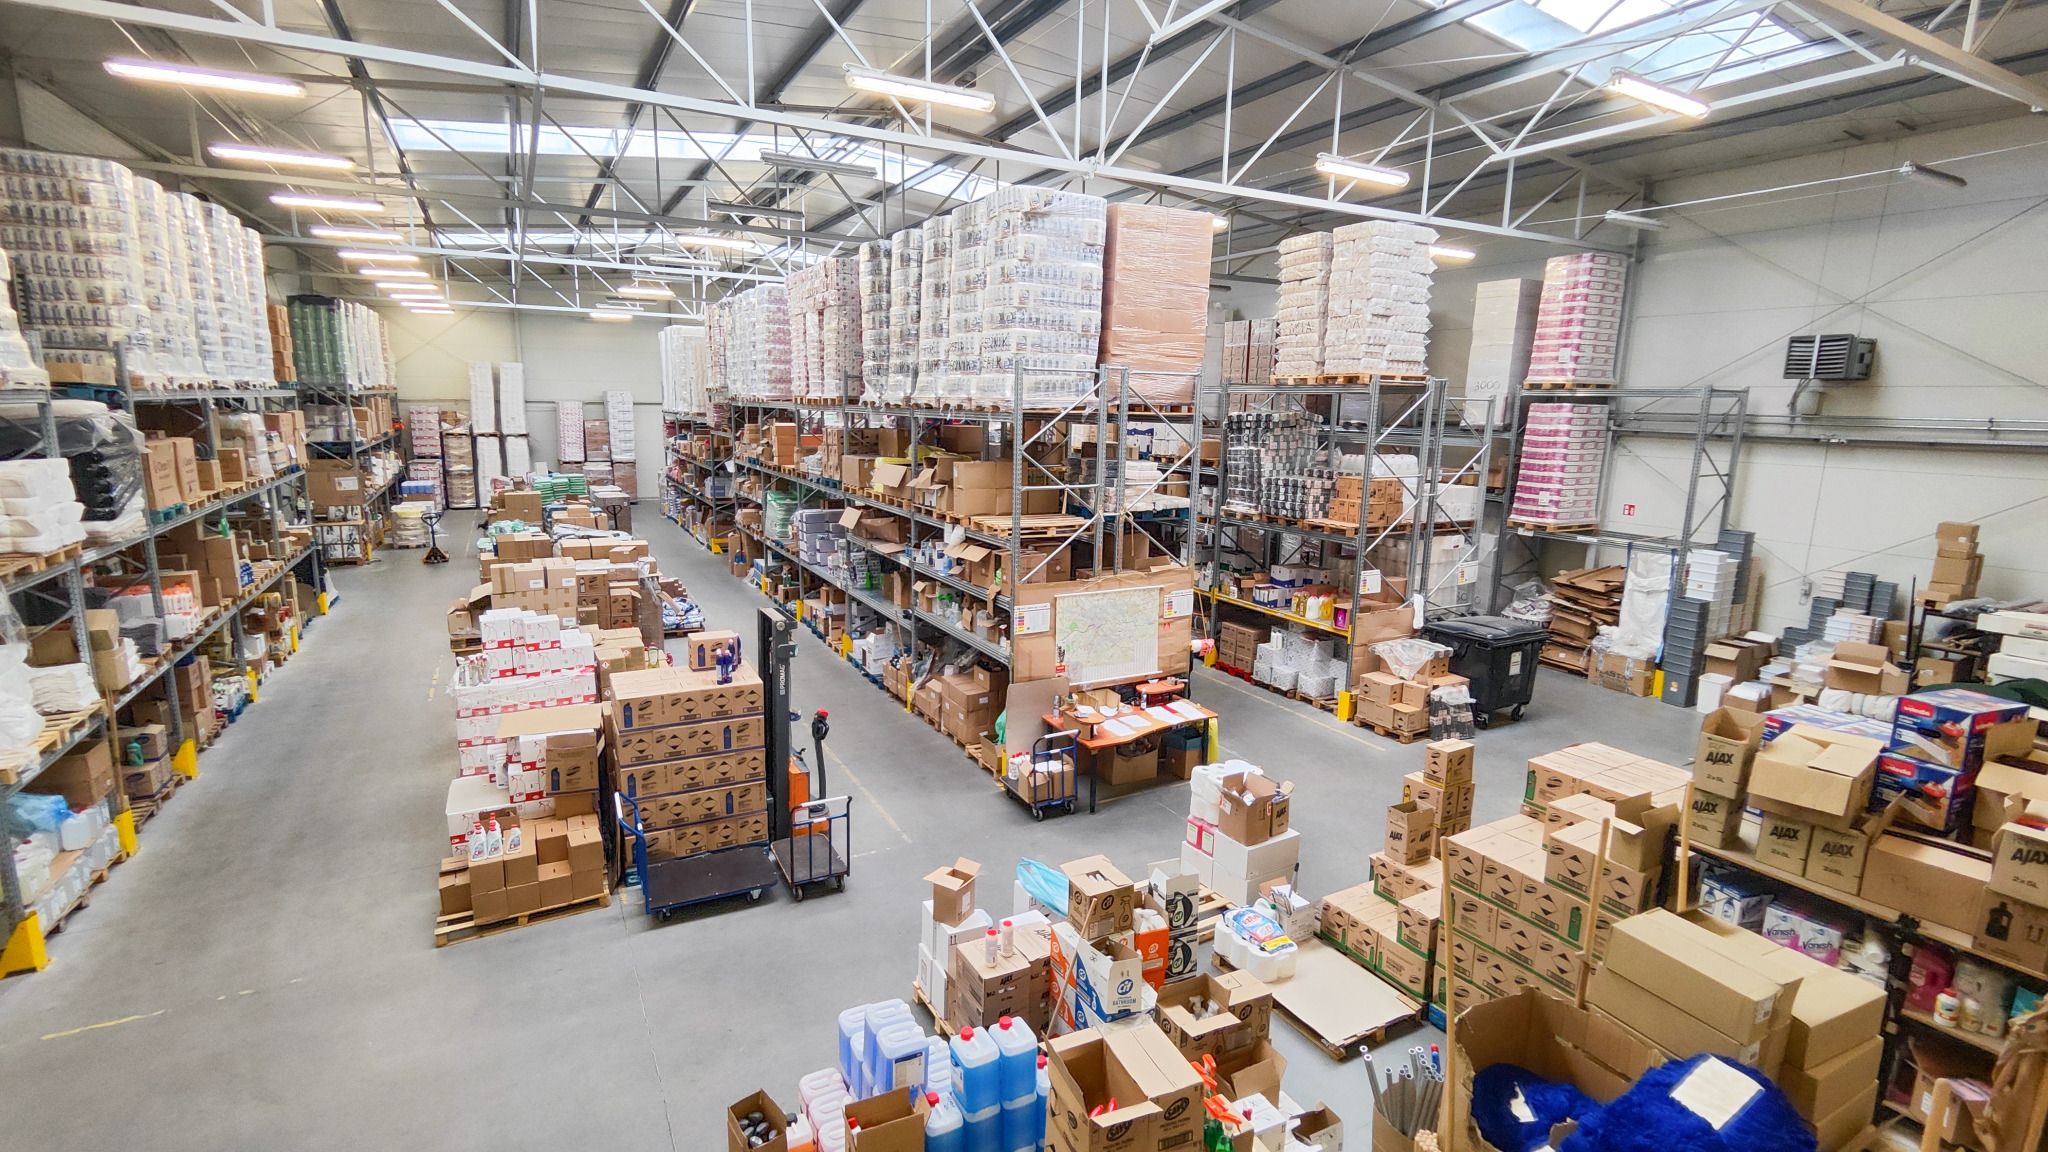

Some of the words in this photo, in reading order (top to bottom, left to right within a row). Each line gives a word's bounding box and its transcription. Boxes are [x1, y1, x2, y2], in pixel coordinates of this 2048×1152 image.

[1473, 380, 1500, 391] 3000
[1904, 706, 1931, 716] vileda
[1705, 751, 1734, 766] AJAX
[1885, 765, 1912, 776] vileda
[1276, 805, 1287, 820] AJAX
[1692, 800, 1719, 814] AJAX
[1389, 830, 1403, 841] AJAX
[1419, 828, 1431, 843] AJAX
[1770, 826, 1800, 841] AJAX
[1820, 842, 1854, 857] AJAX
[1102, 895, 1114, 910] Cif
[1767, 928, 1796, 937] Vanish
[1802, 940, 1833, 951] Vanish
[1118, 980, 1132, 994] Cif
